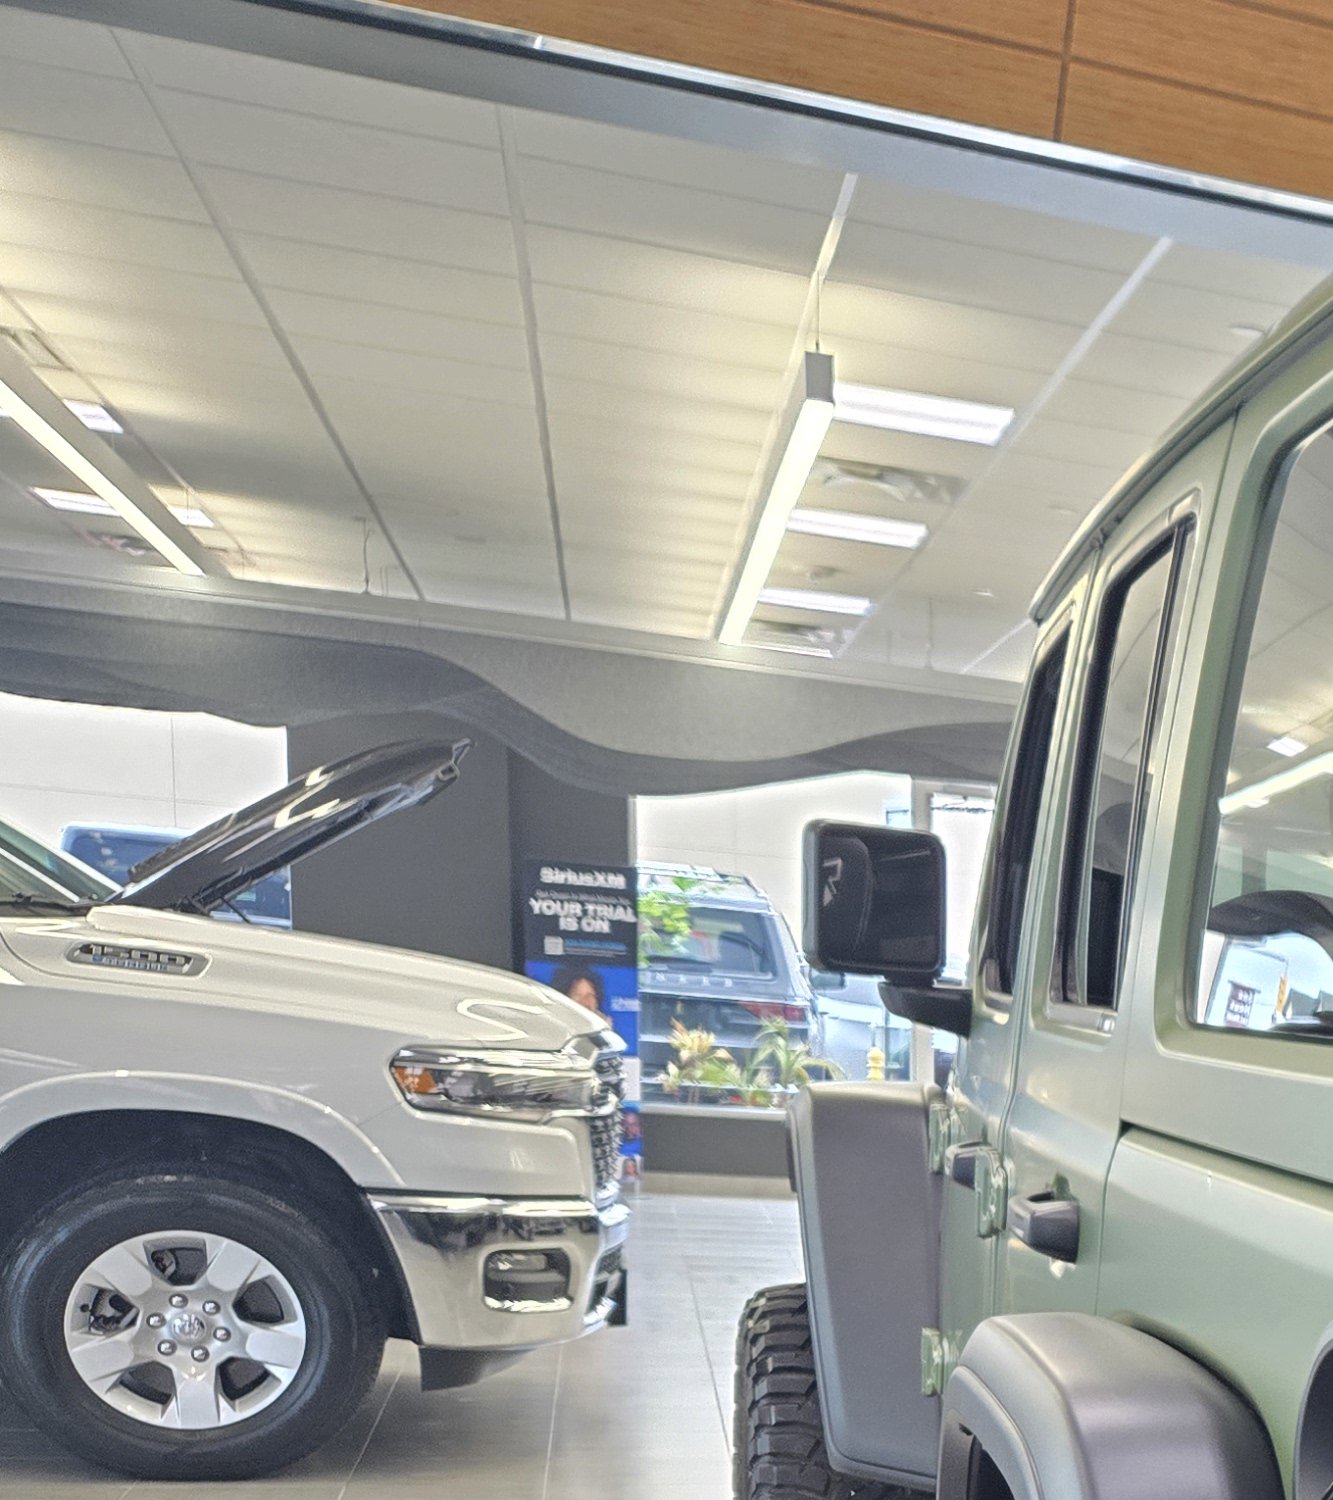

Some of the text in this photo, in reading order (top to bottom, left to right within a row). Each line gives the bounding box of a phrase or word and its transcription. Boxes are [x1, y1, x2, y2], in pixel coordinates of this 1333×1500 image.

[540, 867, 627, 889] SiriusXM
[528, 897, 638, 923] YOUR TRIAL
[558, 916, 611, 934] IS ON
